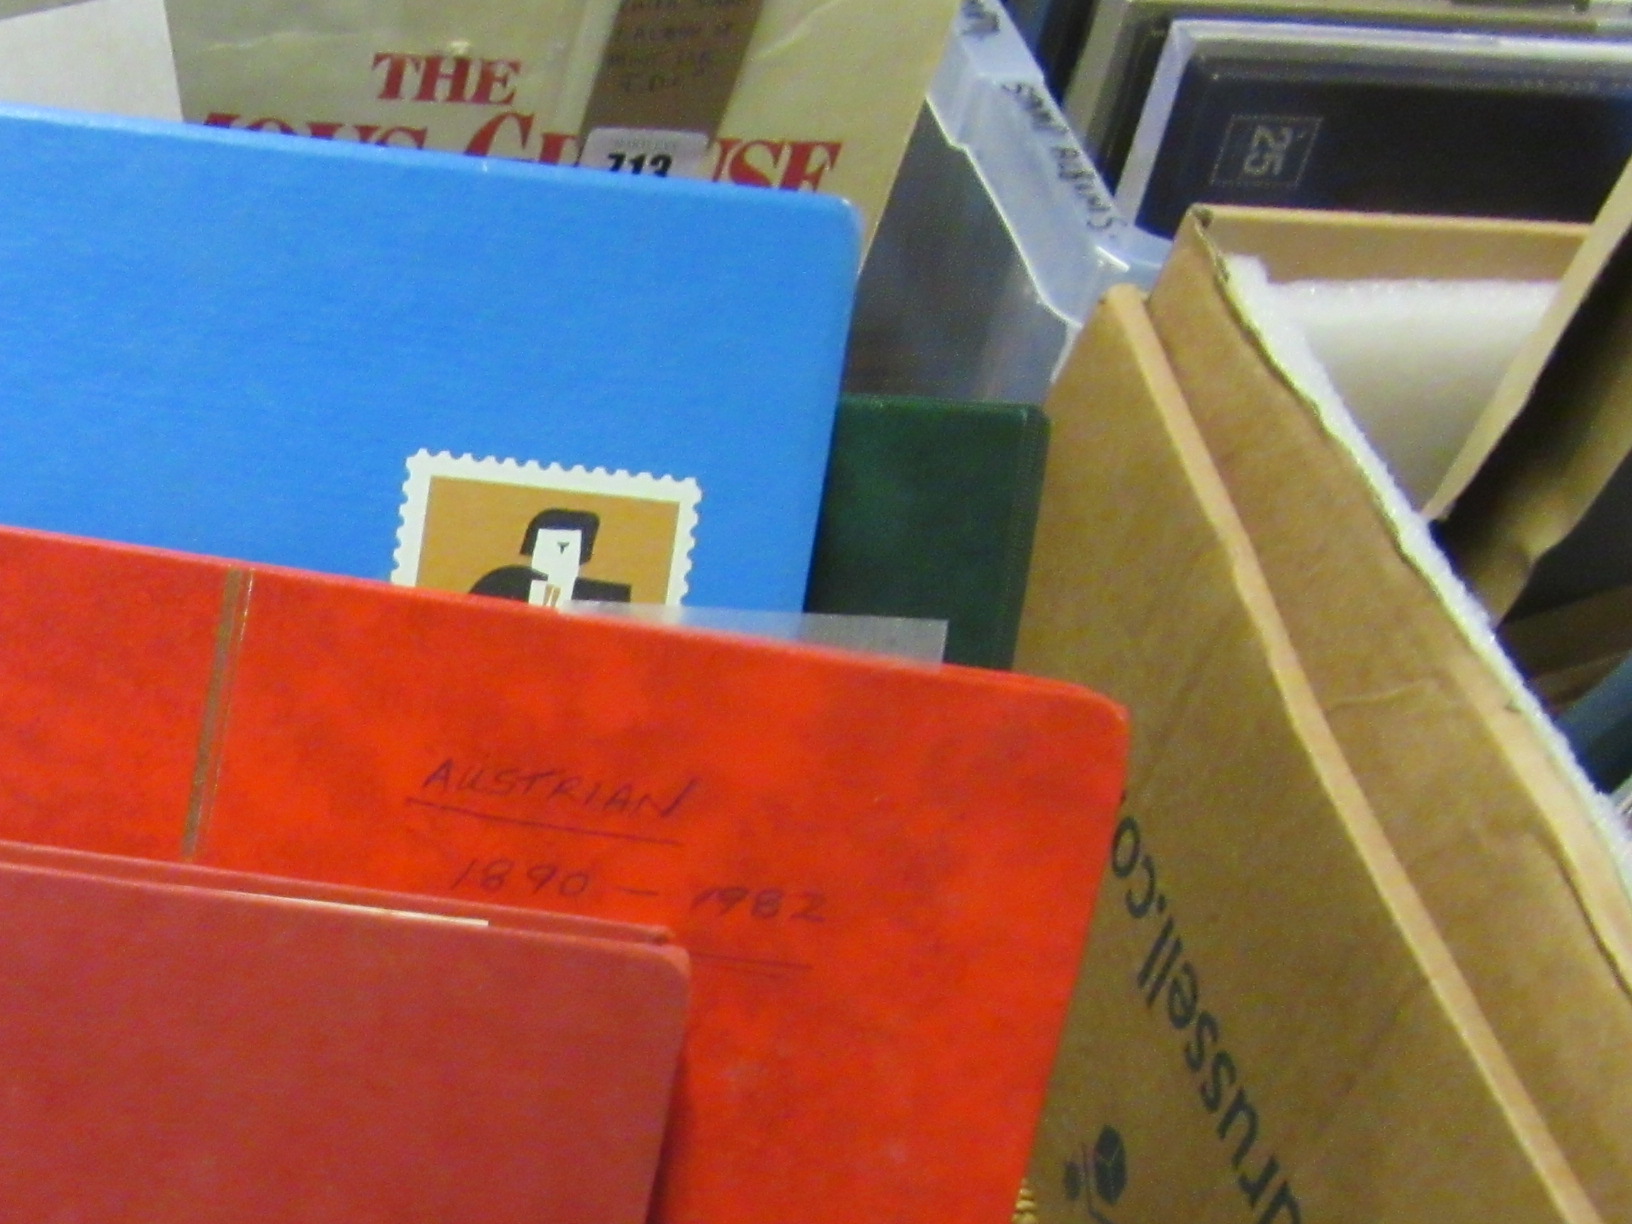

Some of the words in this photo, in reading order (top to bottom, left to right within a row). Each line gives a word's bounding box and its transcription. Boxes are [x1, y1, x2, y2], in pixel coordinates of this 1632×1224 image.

[372, 53, 521, 105] THE
[422, 757, 700, 818] AUSTRIAN
[449, 857, 591, 894] 1890
[690, 885, 827, 924] 1982
